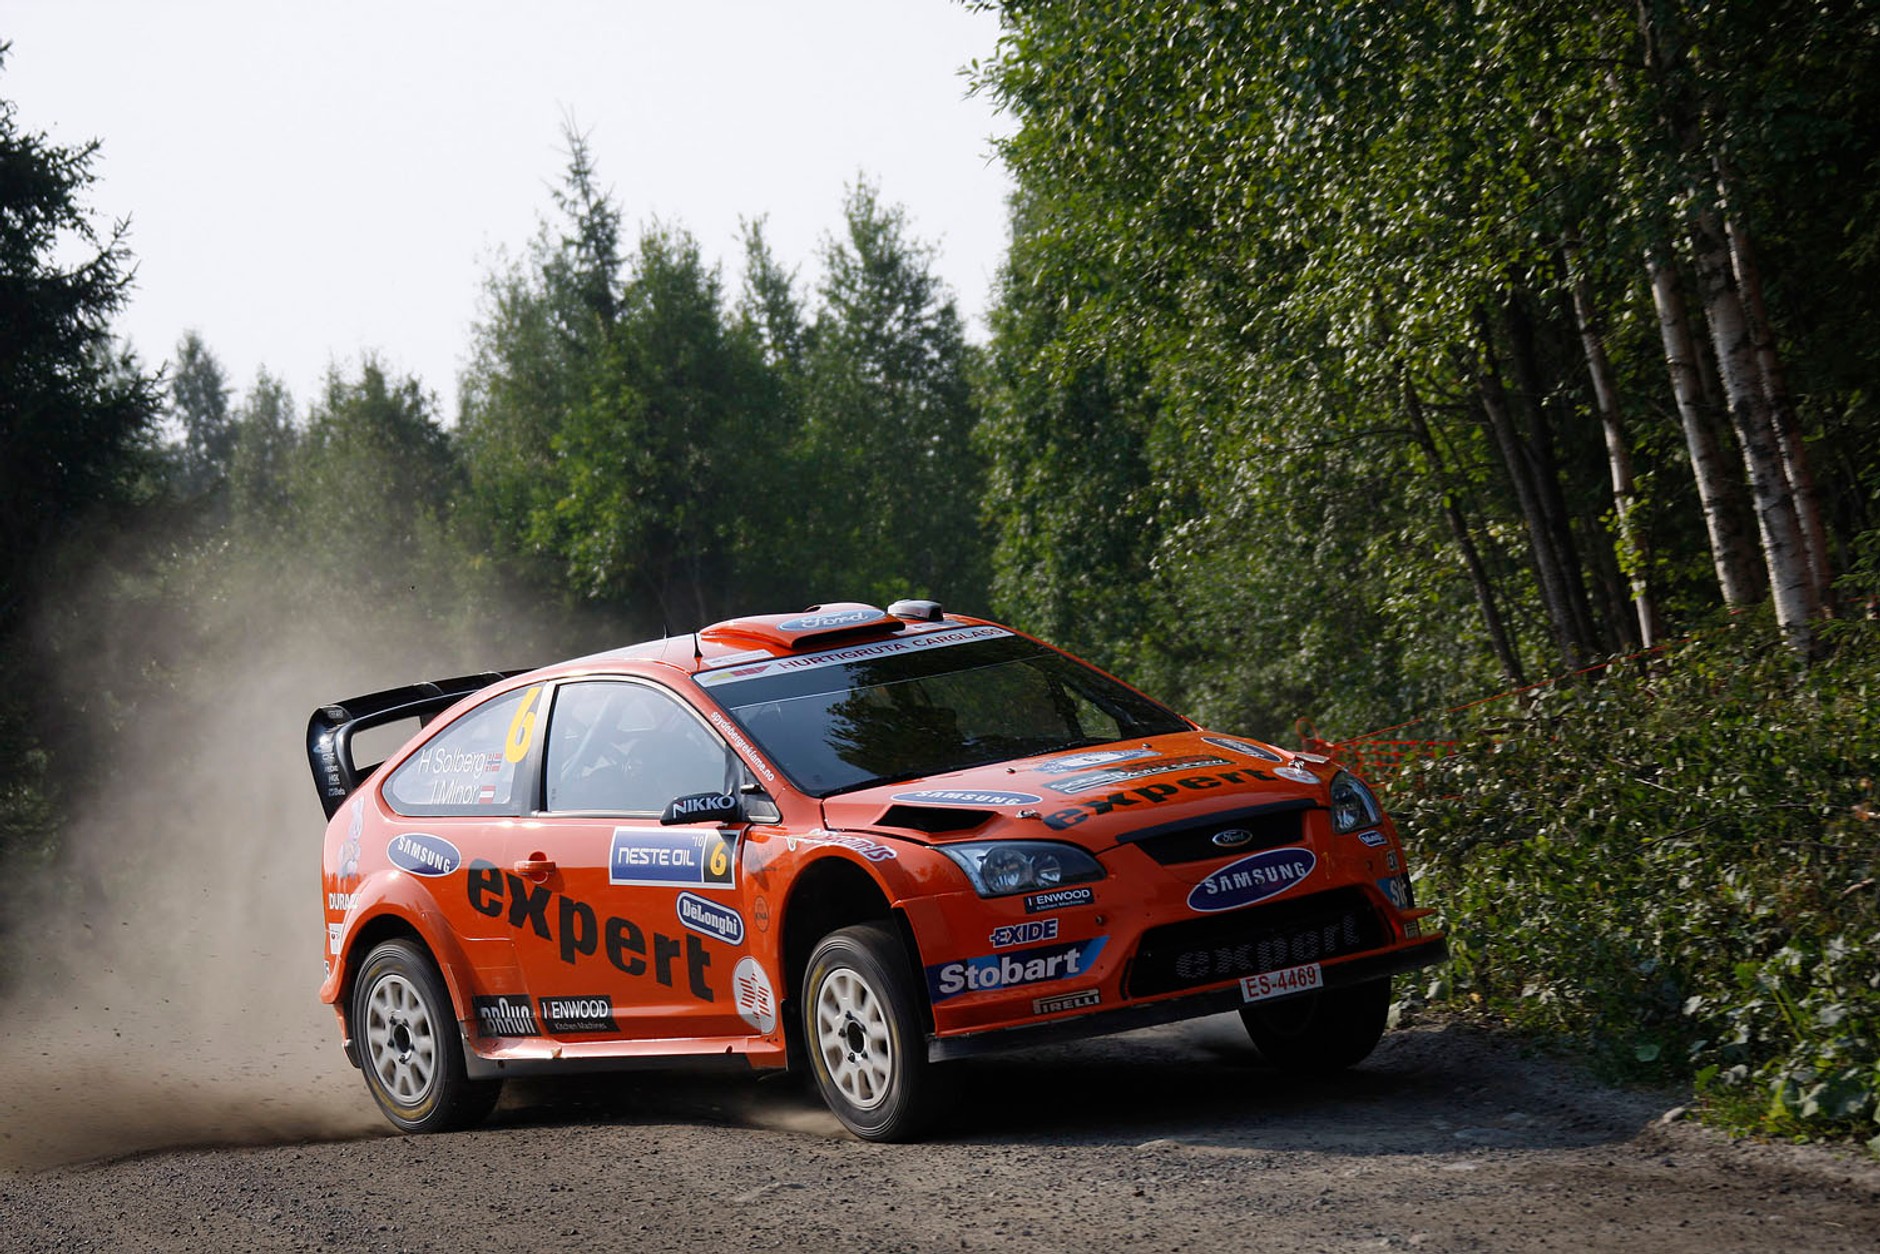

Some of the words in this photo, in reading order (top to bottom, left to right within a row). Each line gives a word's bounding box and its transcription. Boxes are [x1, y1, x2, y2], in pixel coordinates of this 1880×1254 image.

[801, 611, 869, 628] Ford
[777, 643, 907, 669] HURTIGRUTA
[912, 628, 1004, 647] CARGLASS
[505, 686, 542, 763] 6
[418, 748, 434, 774] H
[432, 747, 486, 779] Solberg
[439, 779, 479, 804] Minor
[673, 794, 736, 819] NIKKO
[916, 791, 1021, 806] SAMSUNG
[1043, 768, 1279, 831] expert
[398, 835, 451, 873] SAMSUNG
[618, 847, 669, 866] NESTE
[672, 849, 695, 867] OIL
[710, 842, 727, 876] 6
[1204, 861, 1307, 895] SAMSUNG
[467, 858, 714, 1003] expert
[990, 918, 1059, 948] EXIDE
[1175, 912, 1361, 979] expert
[939, 948, 1081, 994] Stobart
[1245, 965, 1317, 998] ES-4469
[480, 997, 536, 1034] BRAUN
[1032, 988, 1100, 1015] PIRELLI
